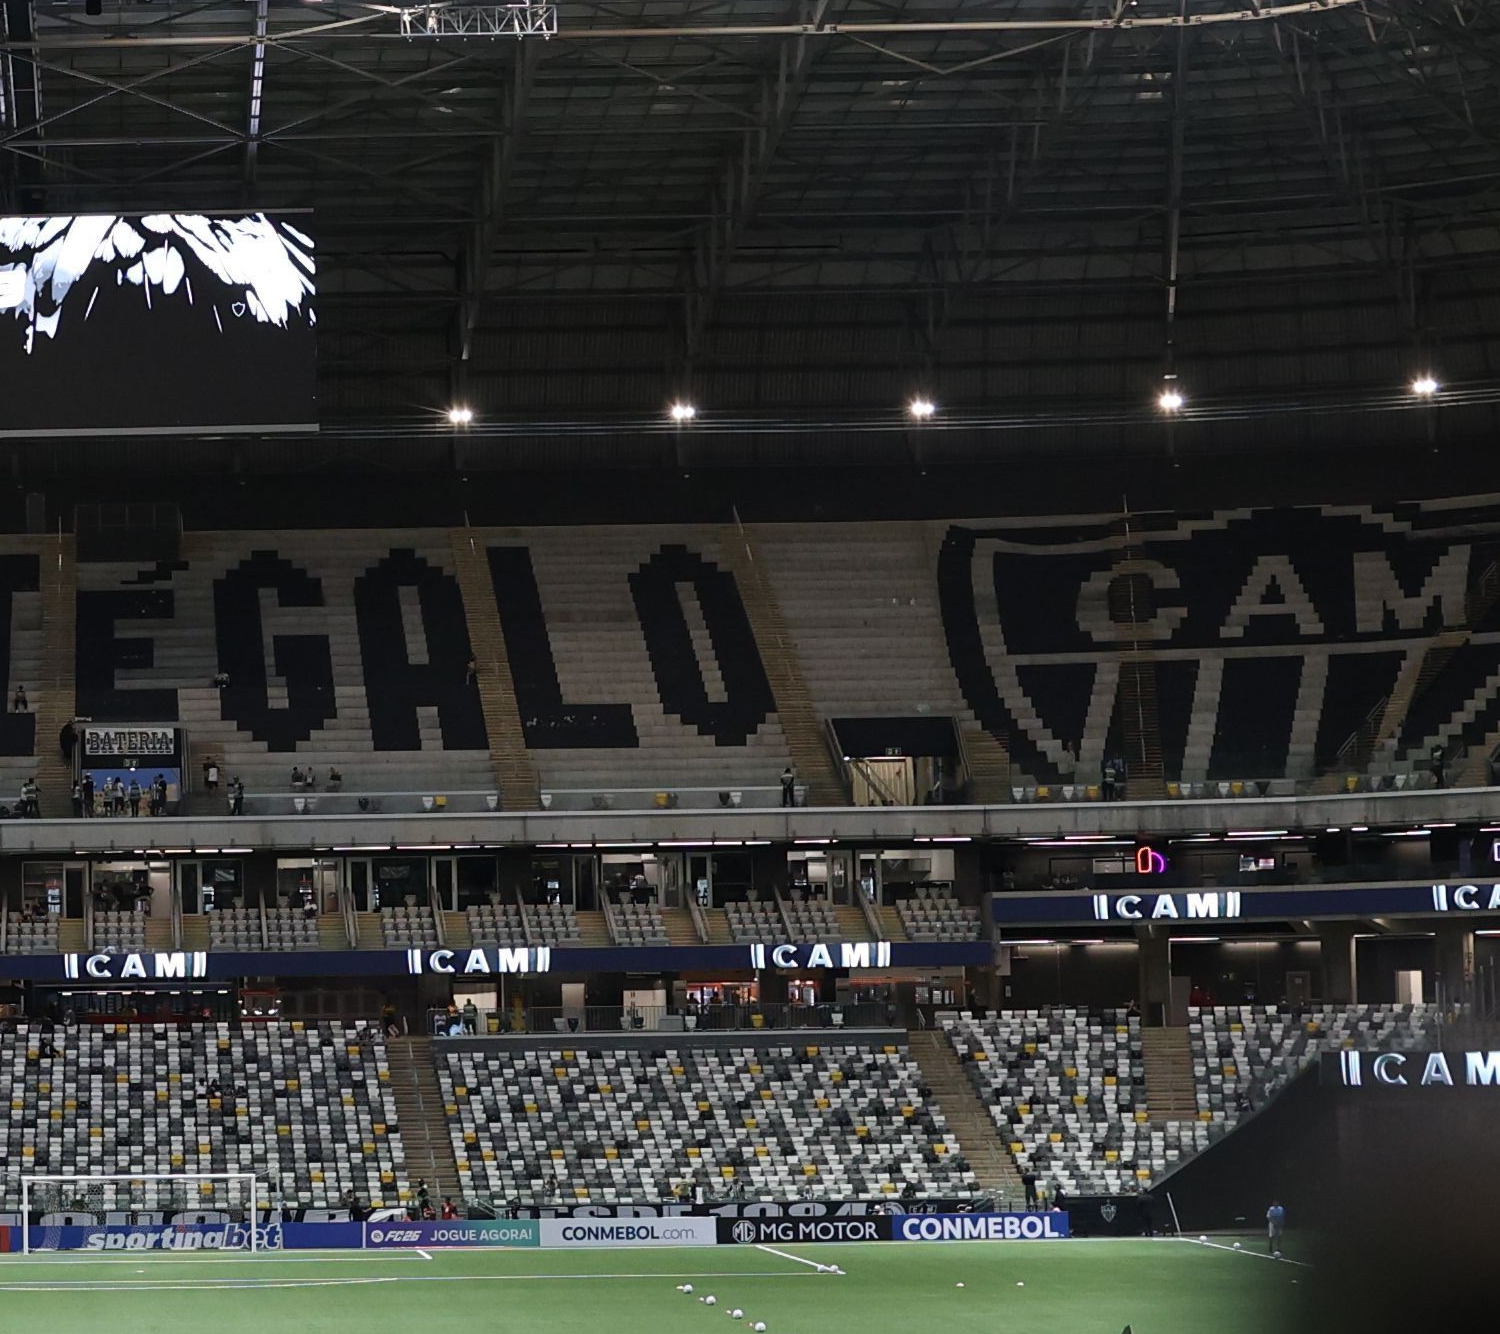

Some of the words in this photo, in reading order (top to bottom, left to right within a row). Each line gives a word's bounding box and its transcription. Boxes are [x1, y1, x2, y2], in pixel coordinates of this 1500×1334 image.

[1075, 544, 1472, 644] CAM
[75, 559, 189, 721] É
[213, 544, 777, 752] GALO
[89, 731, 169, 750] BATERIA
[1116, 893, 1218, 918] CAM
[87, 953, 185, 978] CAM
[430, 948, 528, 973] CAM
[773, 943, 869, 968] CAM
[430, 1229, 477, 1242] JOGUE
[480, 1228, 532, 1241] AGORA!
[760, 1223, 793, 1241] MG
[799, 1222, 879, 1240] MOTOR
[902, 1216, 1061, 1240] CONMEBOL
